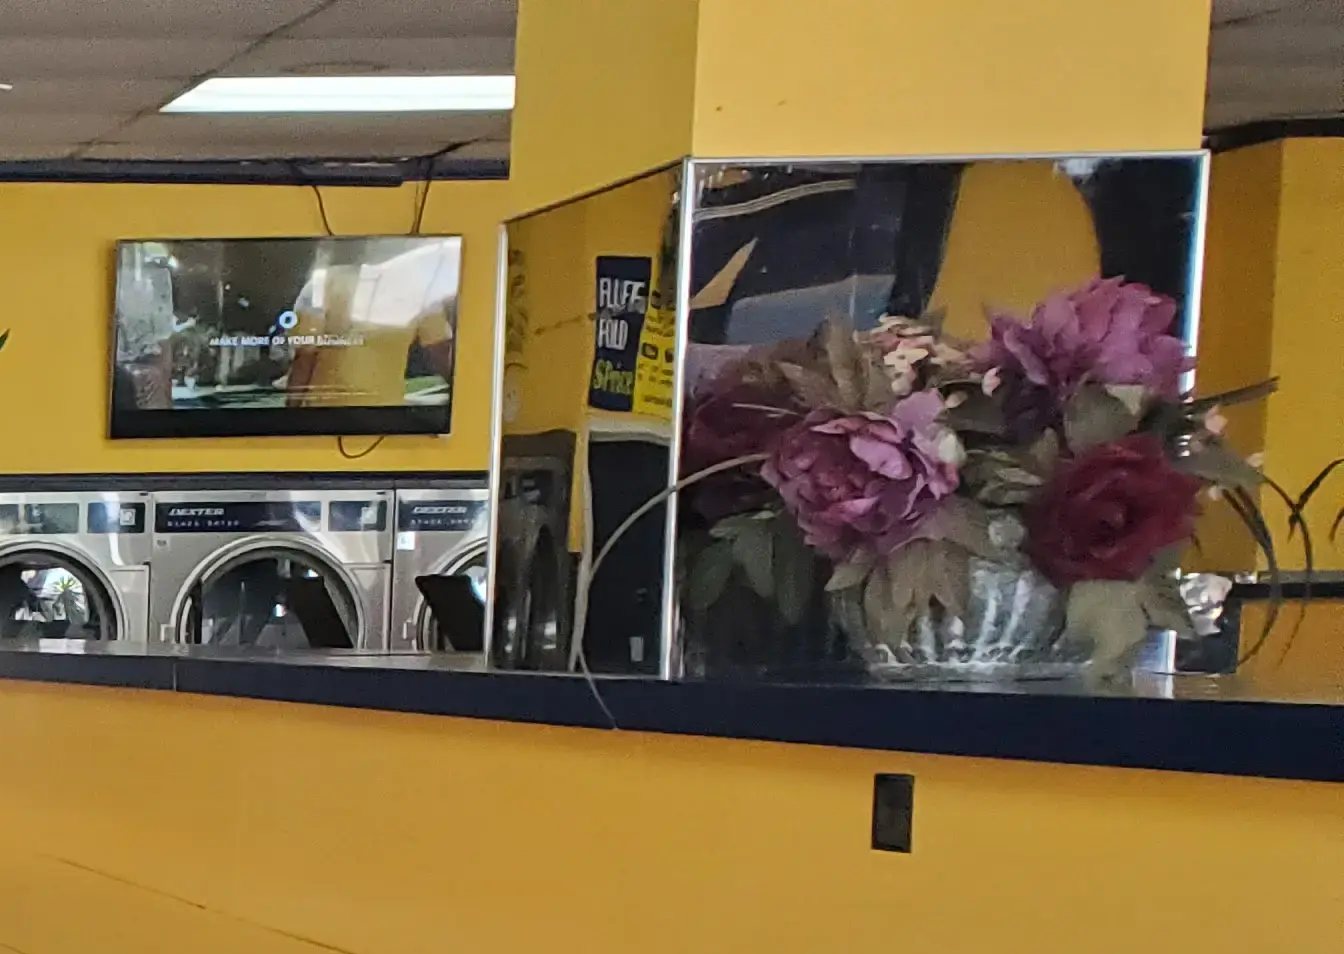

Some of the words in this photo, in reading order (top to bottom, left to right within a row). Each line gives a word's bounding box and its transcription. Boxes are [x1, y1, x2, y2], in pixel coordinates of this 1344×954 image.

[209, 335, 238, 346] MAKE
[241, 335, 270, 345] MORE
[287, 335, 315, 345] YOUR
[168, 508, 225, 516] DEXTER
